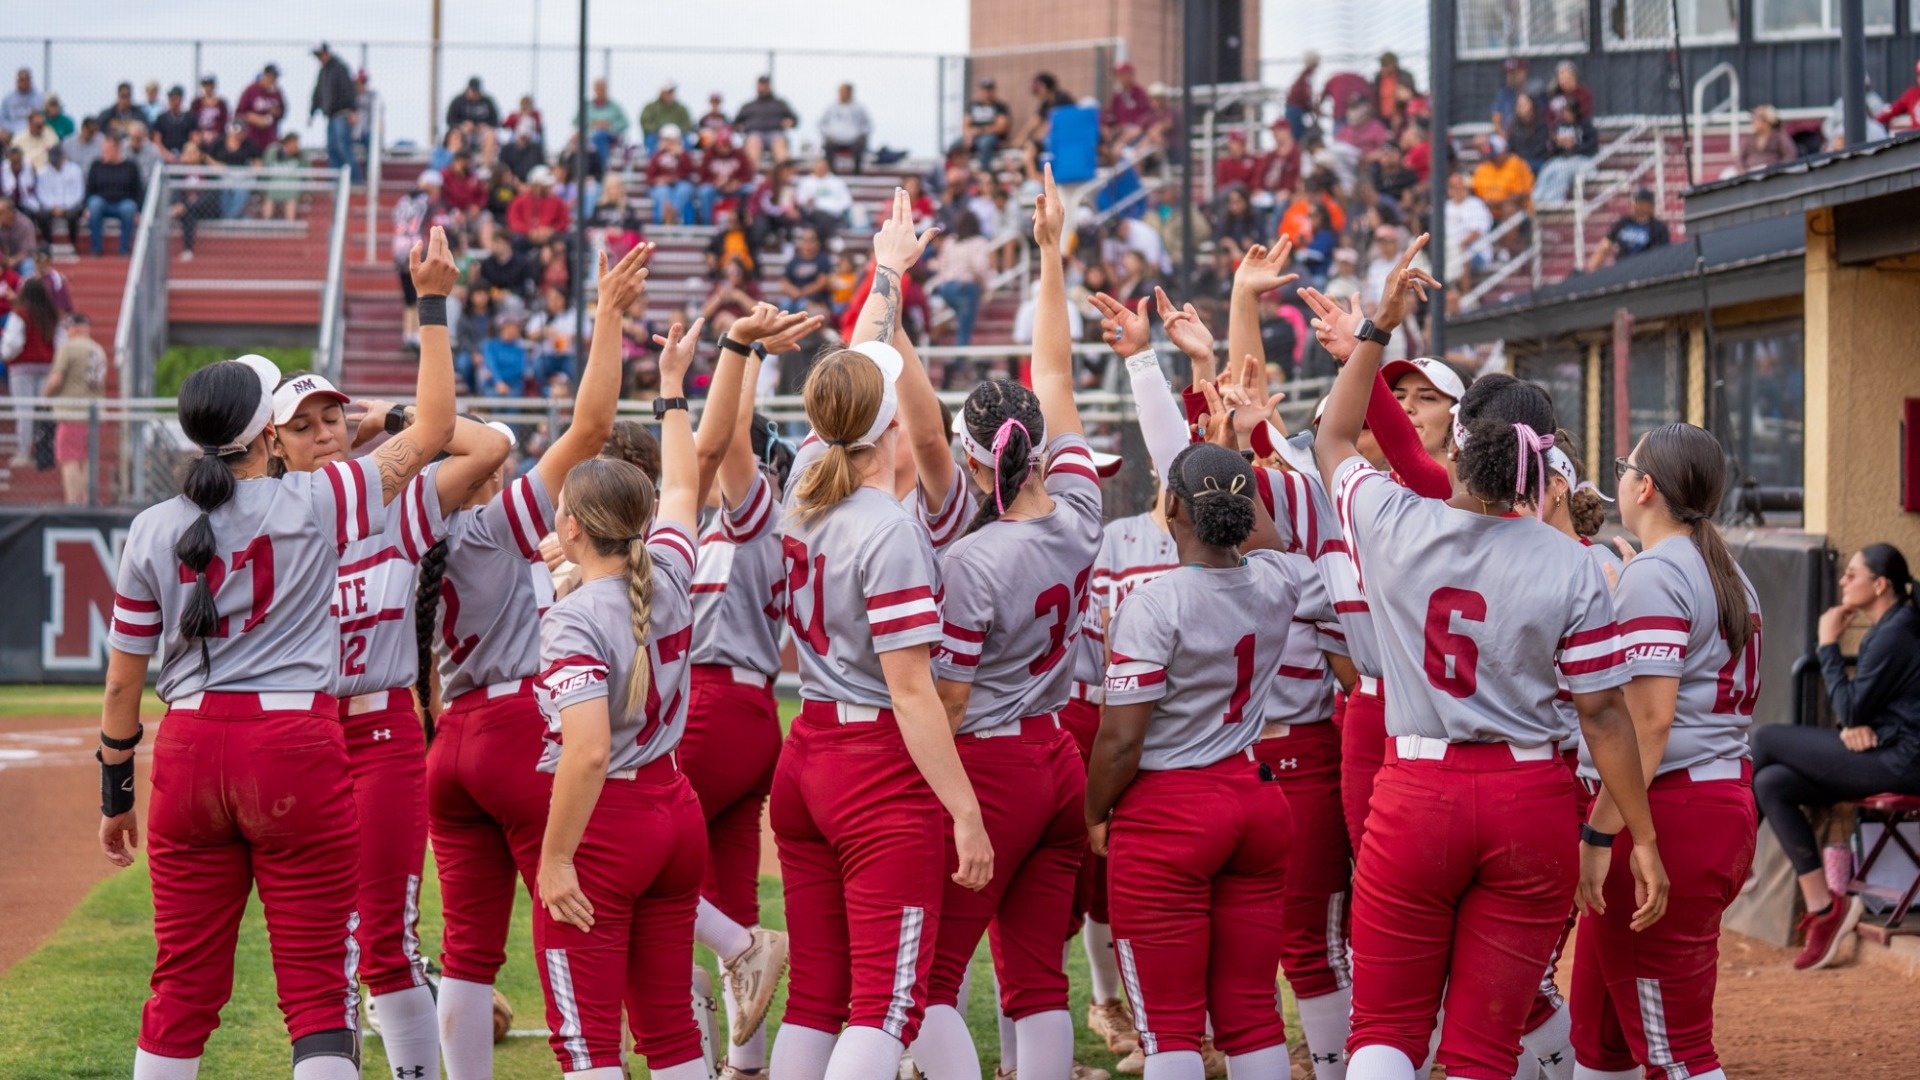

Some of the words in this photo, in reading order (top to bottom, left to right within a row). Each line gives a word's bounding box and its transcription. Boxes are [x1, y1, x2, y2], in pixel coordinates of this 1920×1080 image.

[42, 528, 160, 670] N
[330, 576, 368, 617] TE
[1423, 586, 1488, 699] 6
[1222, 632, 1256, 727] 1
